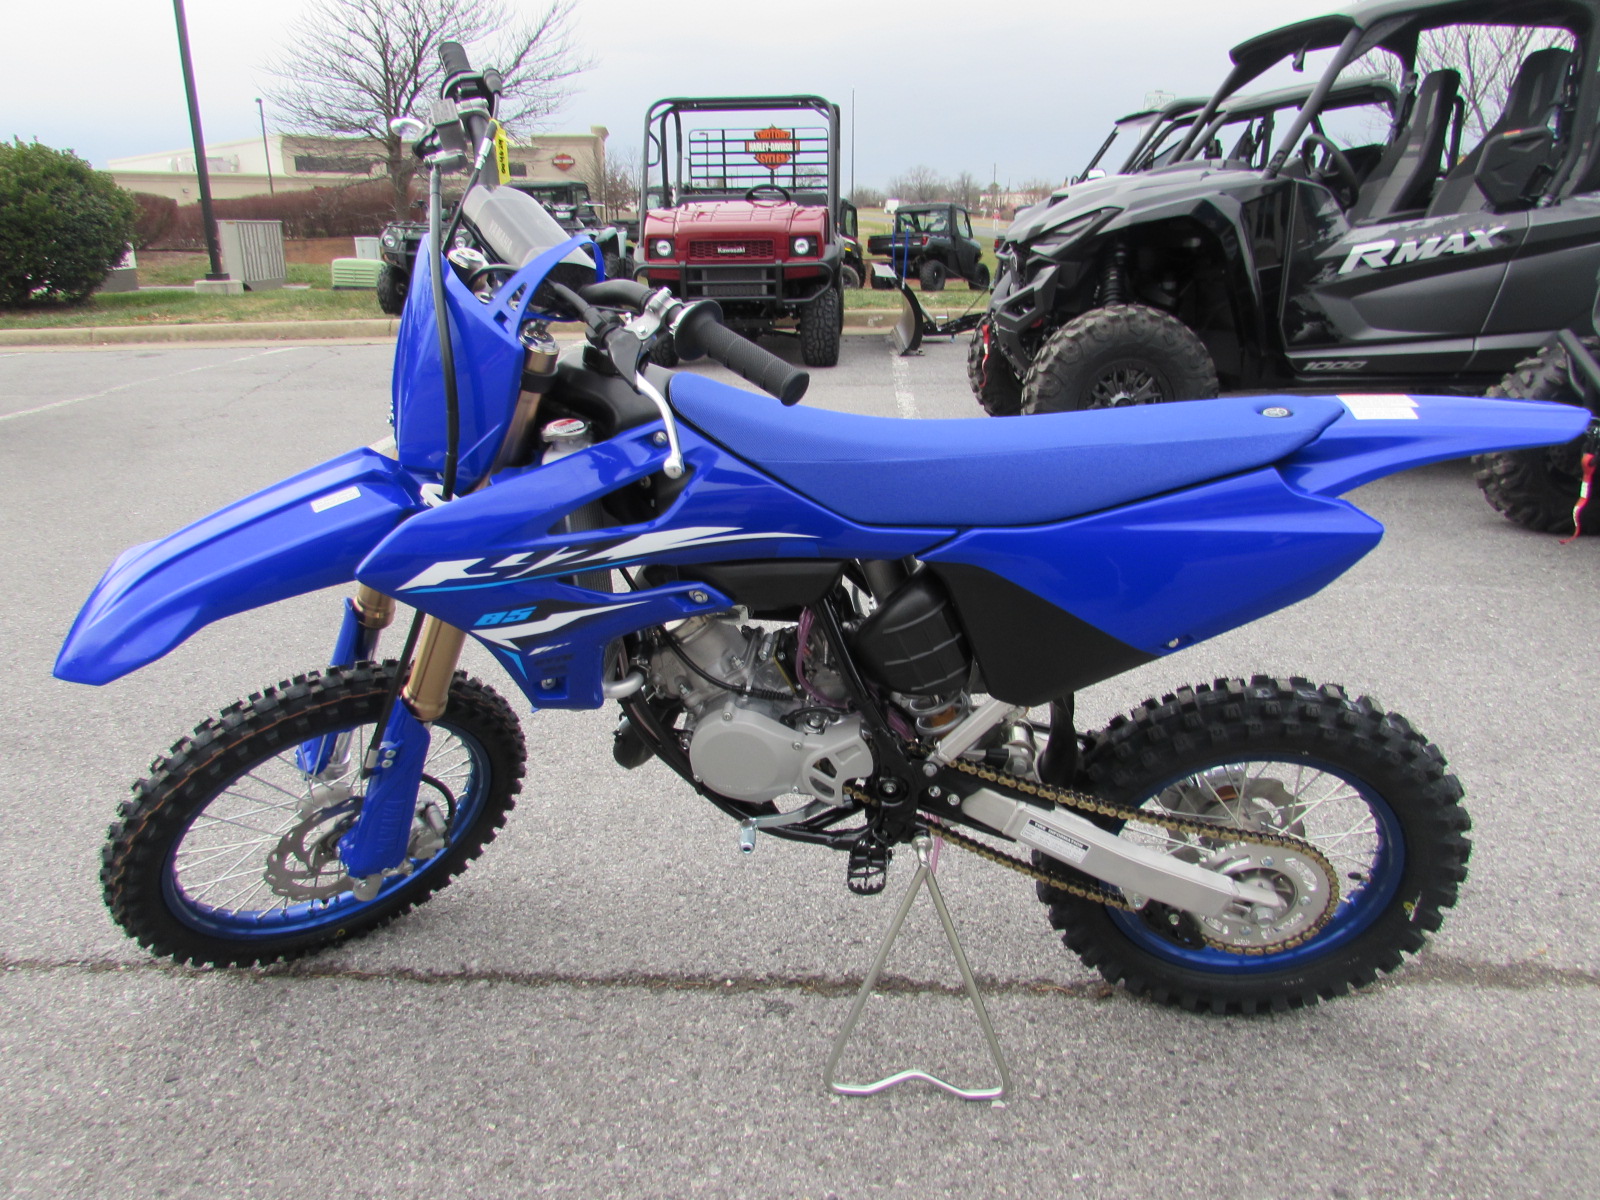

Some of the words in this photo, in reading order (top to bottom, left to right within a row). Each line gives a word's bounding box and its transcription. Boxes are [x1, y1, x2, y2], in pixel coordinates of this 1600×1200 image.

[749, 141, 796, 152] HARLEY-DAVIDSO
[717, 246, 746, 254] Kawasaki
[1338, 225, 1506, 275] RMAX
[1303, 361, 1368, 371] 1000
[473, 606, 537, 627] 85
